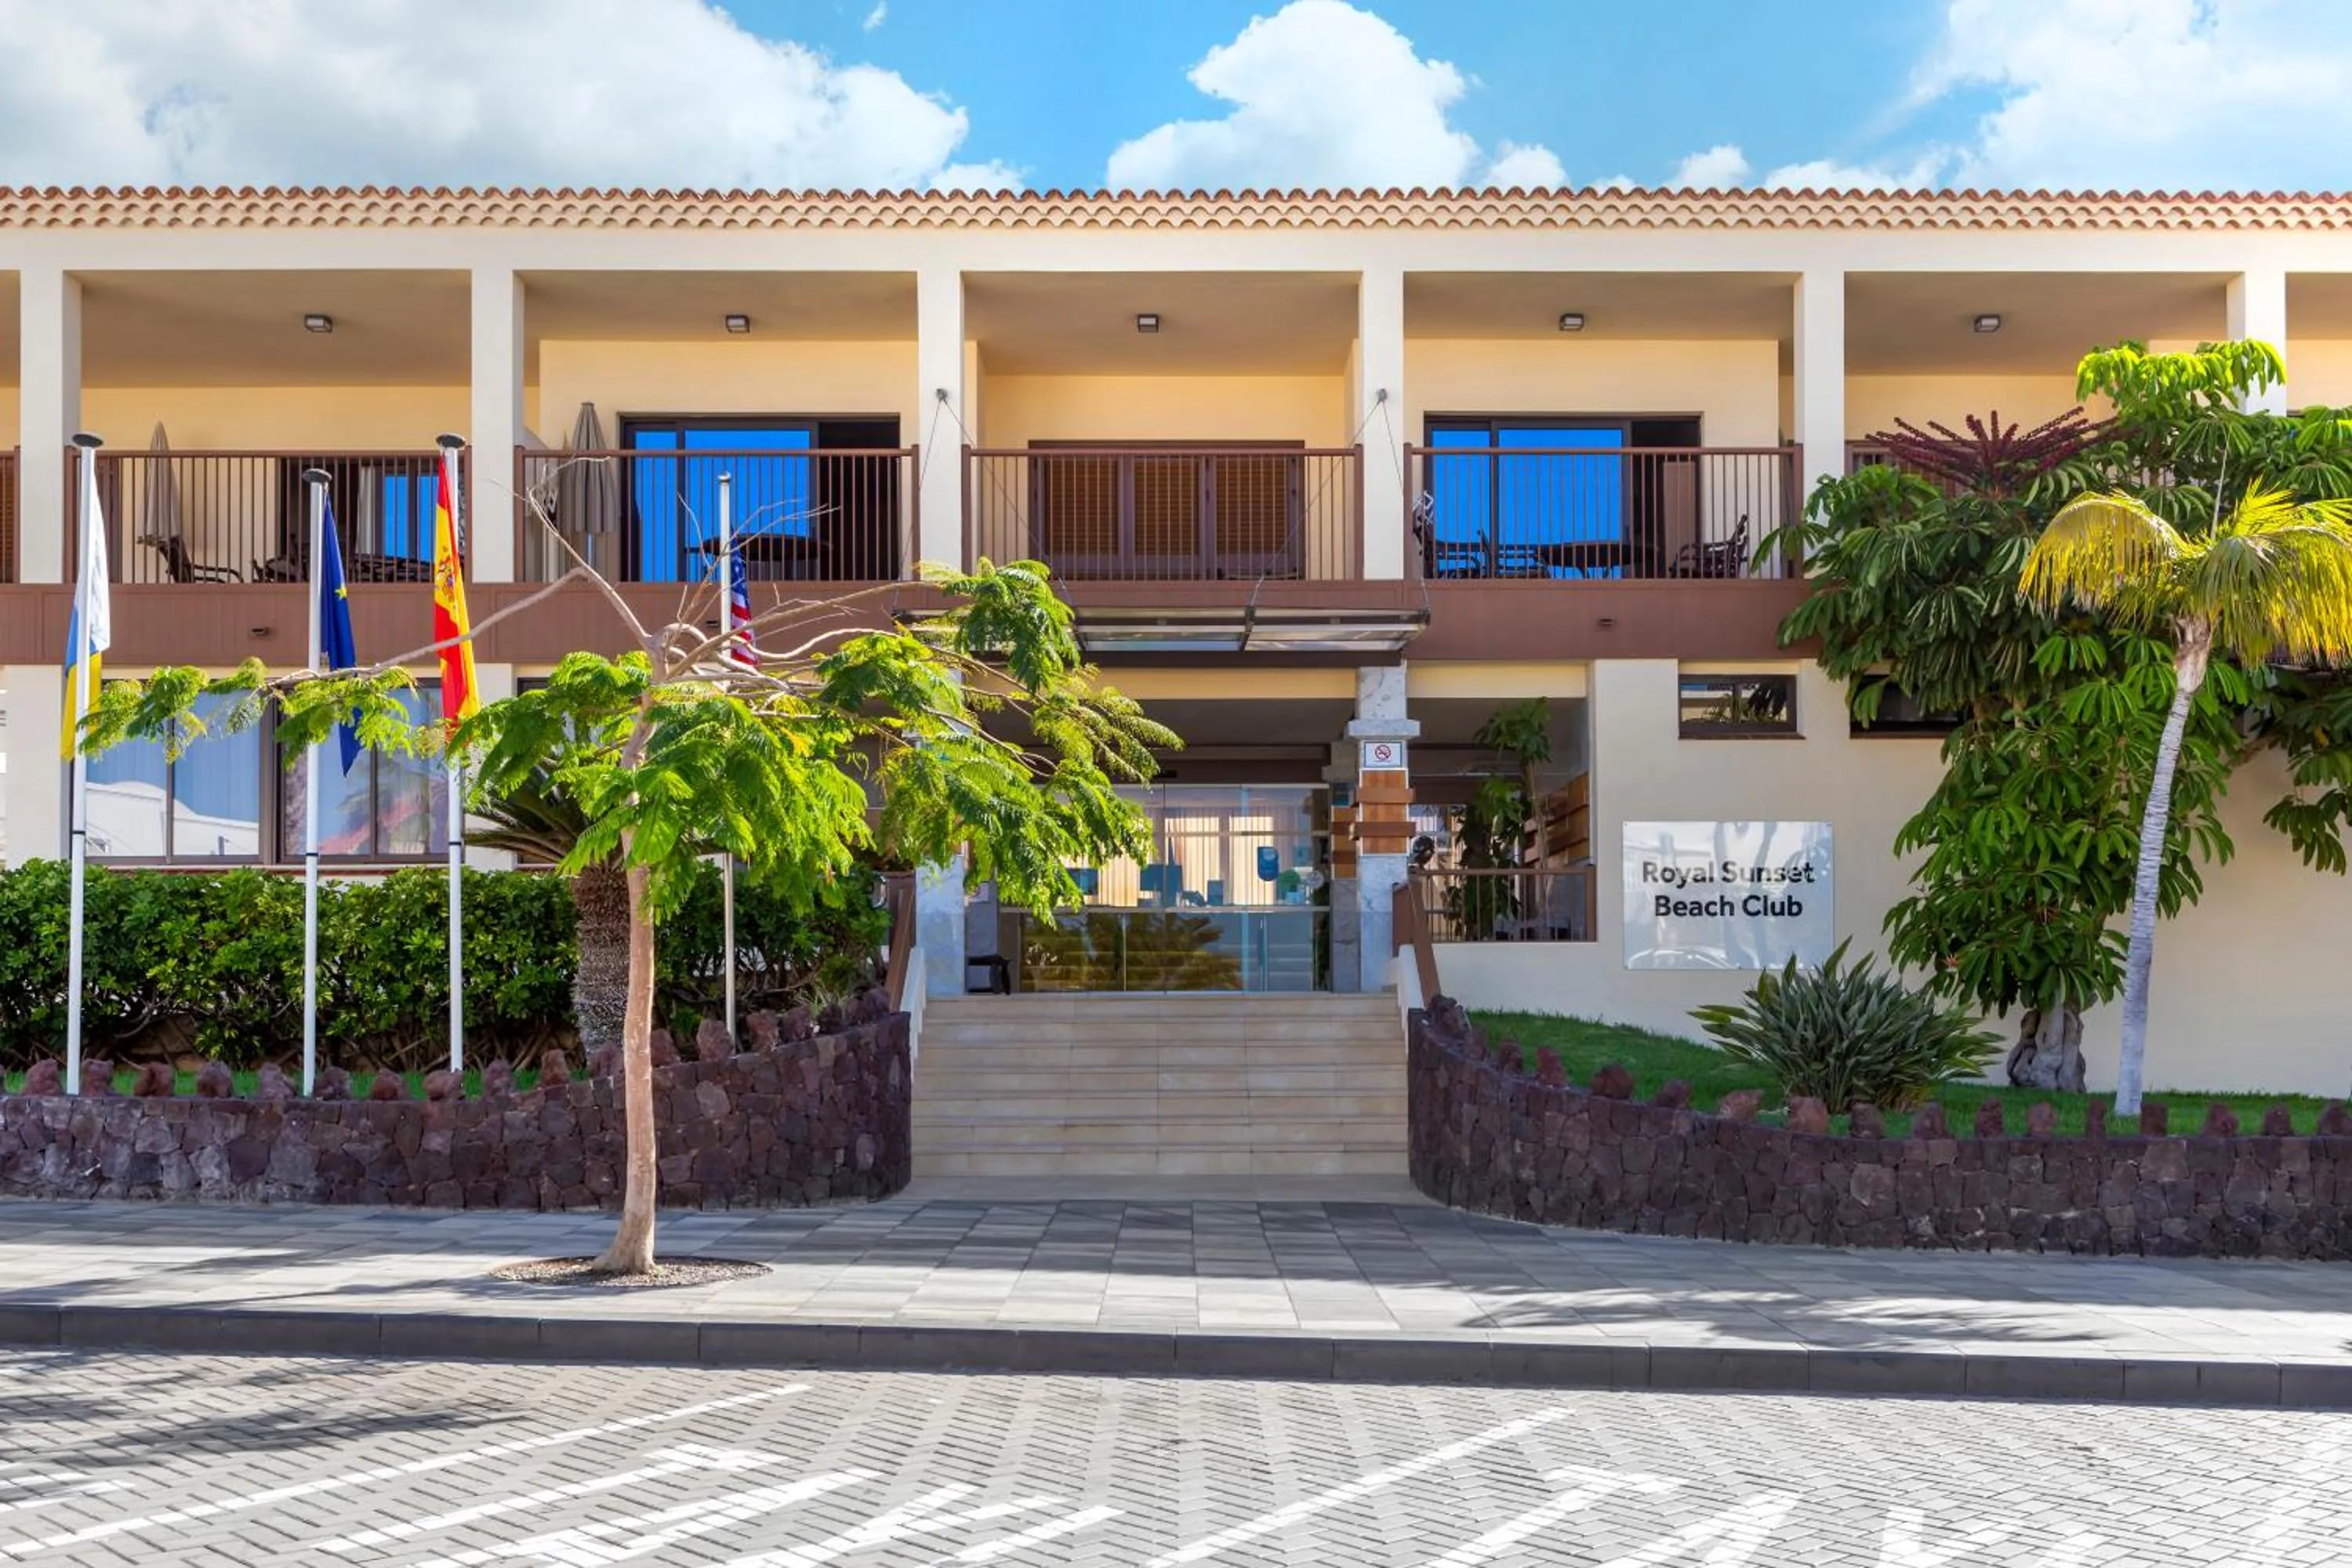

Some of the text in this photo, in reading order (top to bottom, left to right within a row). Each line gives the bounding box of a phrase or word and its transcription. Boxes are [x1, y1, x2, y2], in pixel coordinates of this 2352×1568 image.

[1642, 862, 1815, 888] Royal Sunset
[1655, 895, 1803, 916] Beach Club
